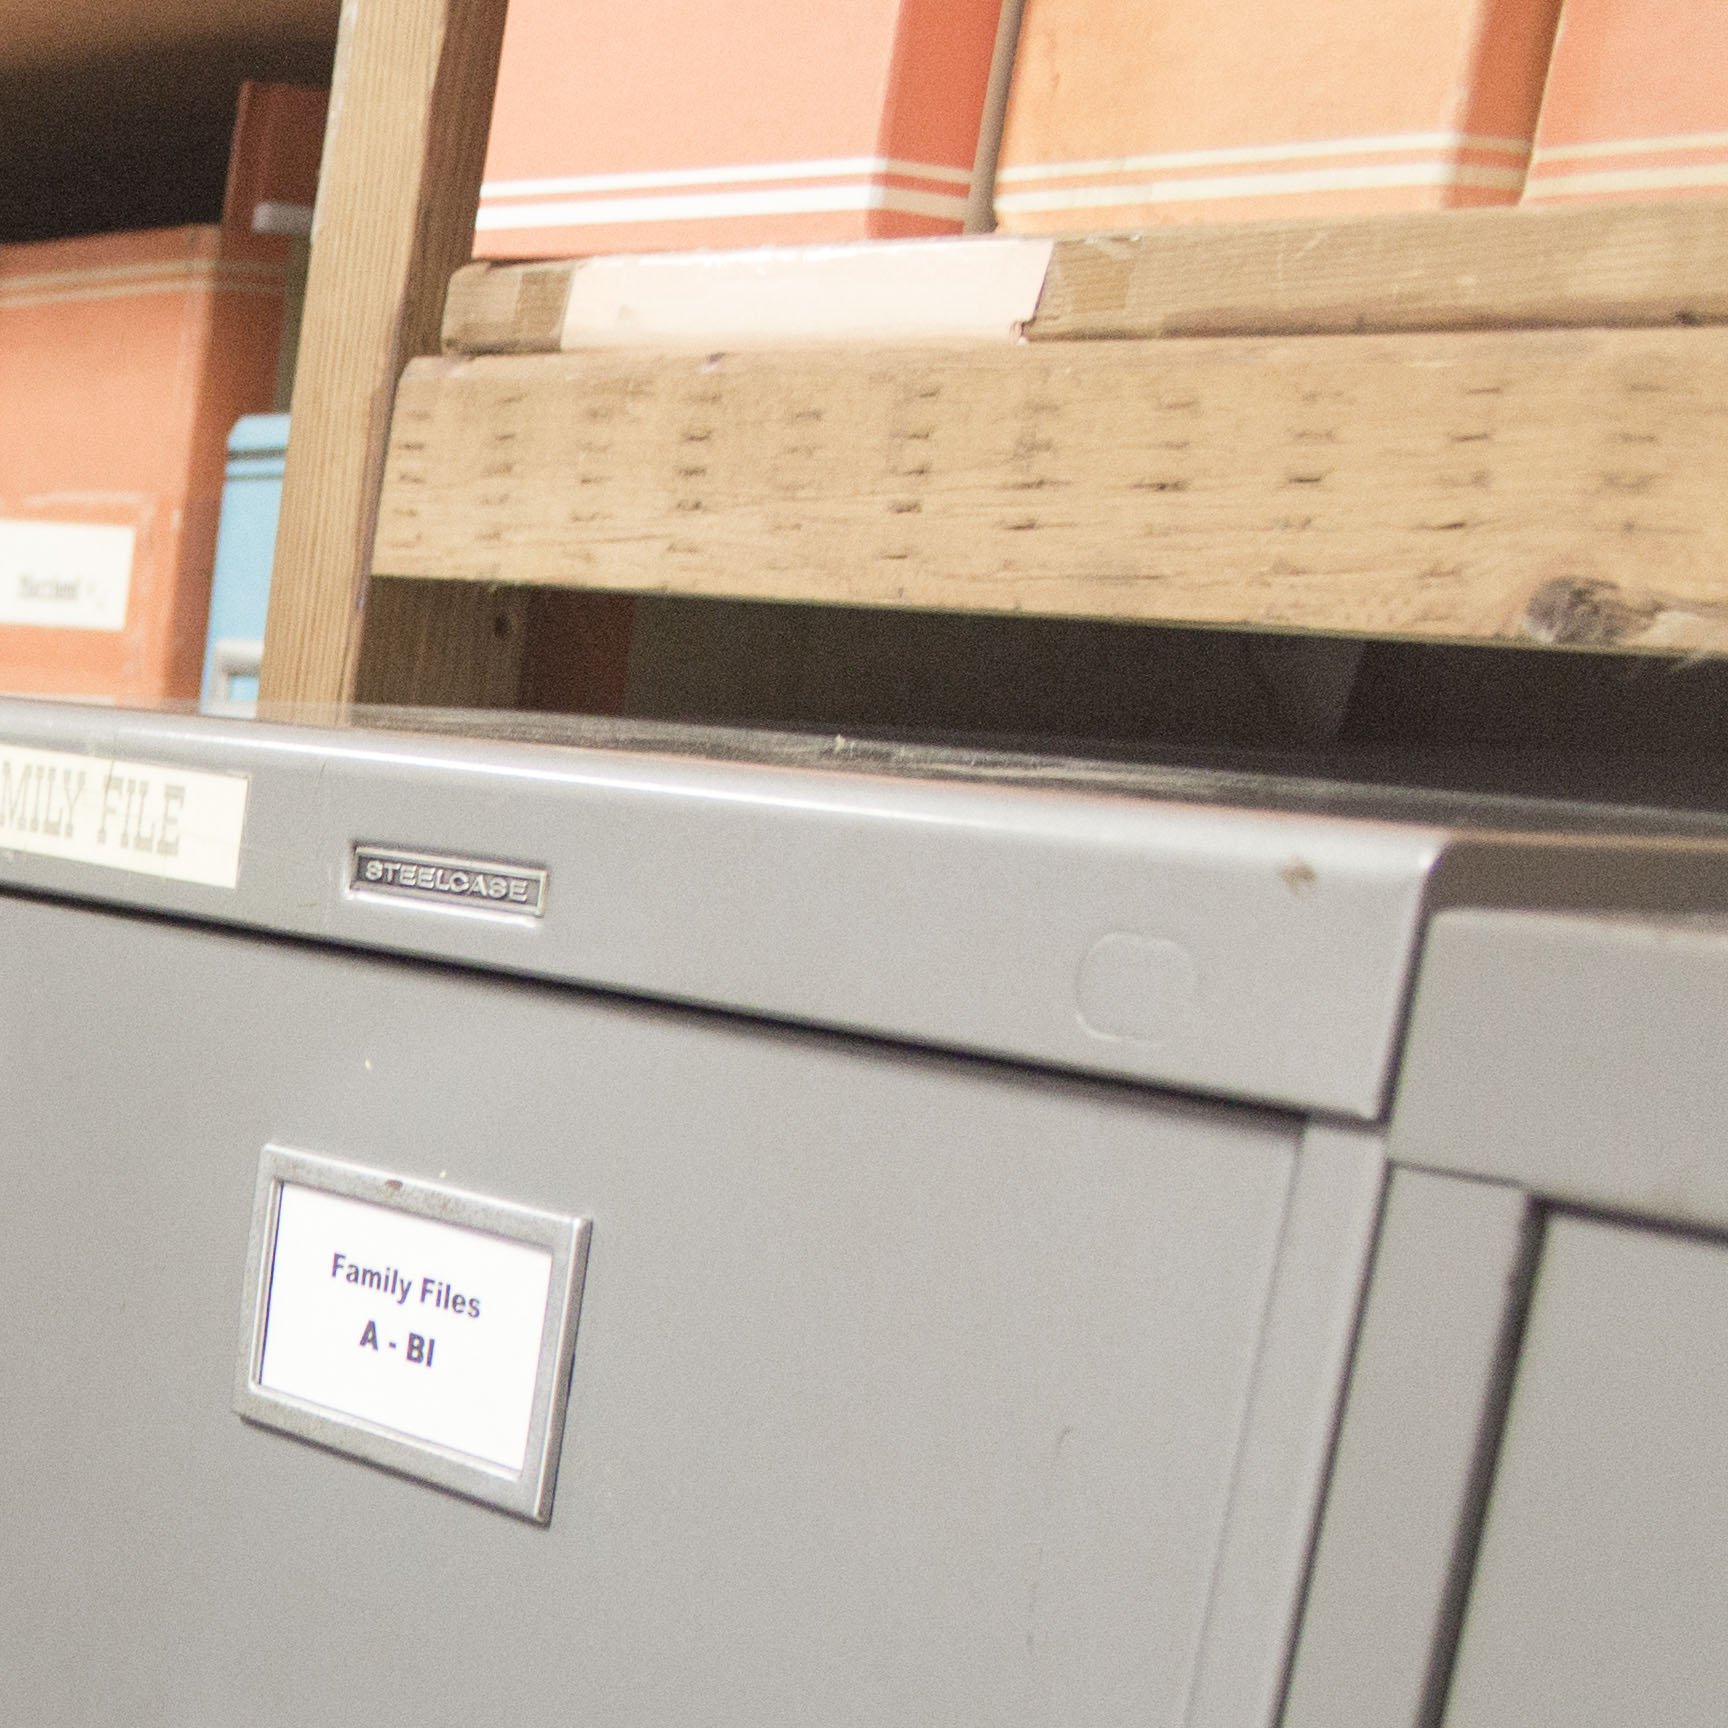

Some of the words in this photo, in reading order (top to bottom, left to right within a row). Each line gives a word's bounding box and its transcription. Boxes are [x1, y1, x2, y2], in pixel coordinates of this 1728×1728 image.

[96, 763, 186, 858] FILE
[364, 858, 529, 904] STEELCASE
[331, 1252, 412, 1305] Family
[420, 1277, 481, 1318] Files
[359, 1320, 379, 1351] A
